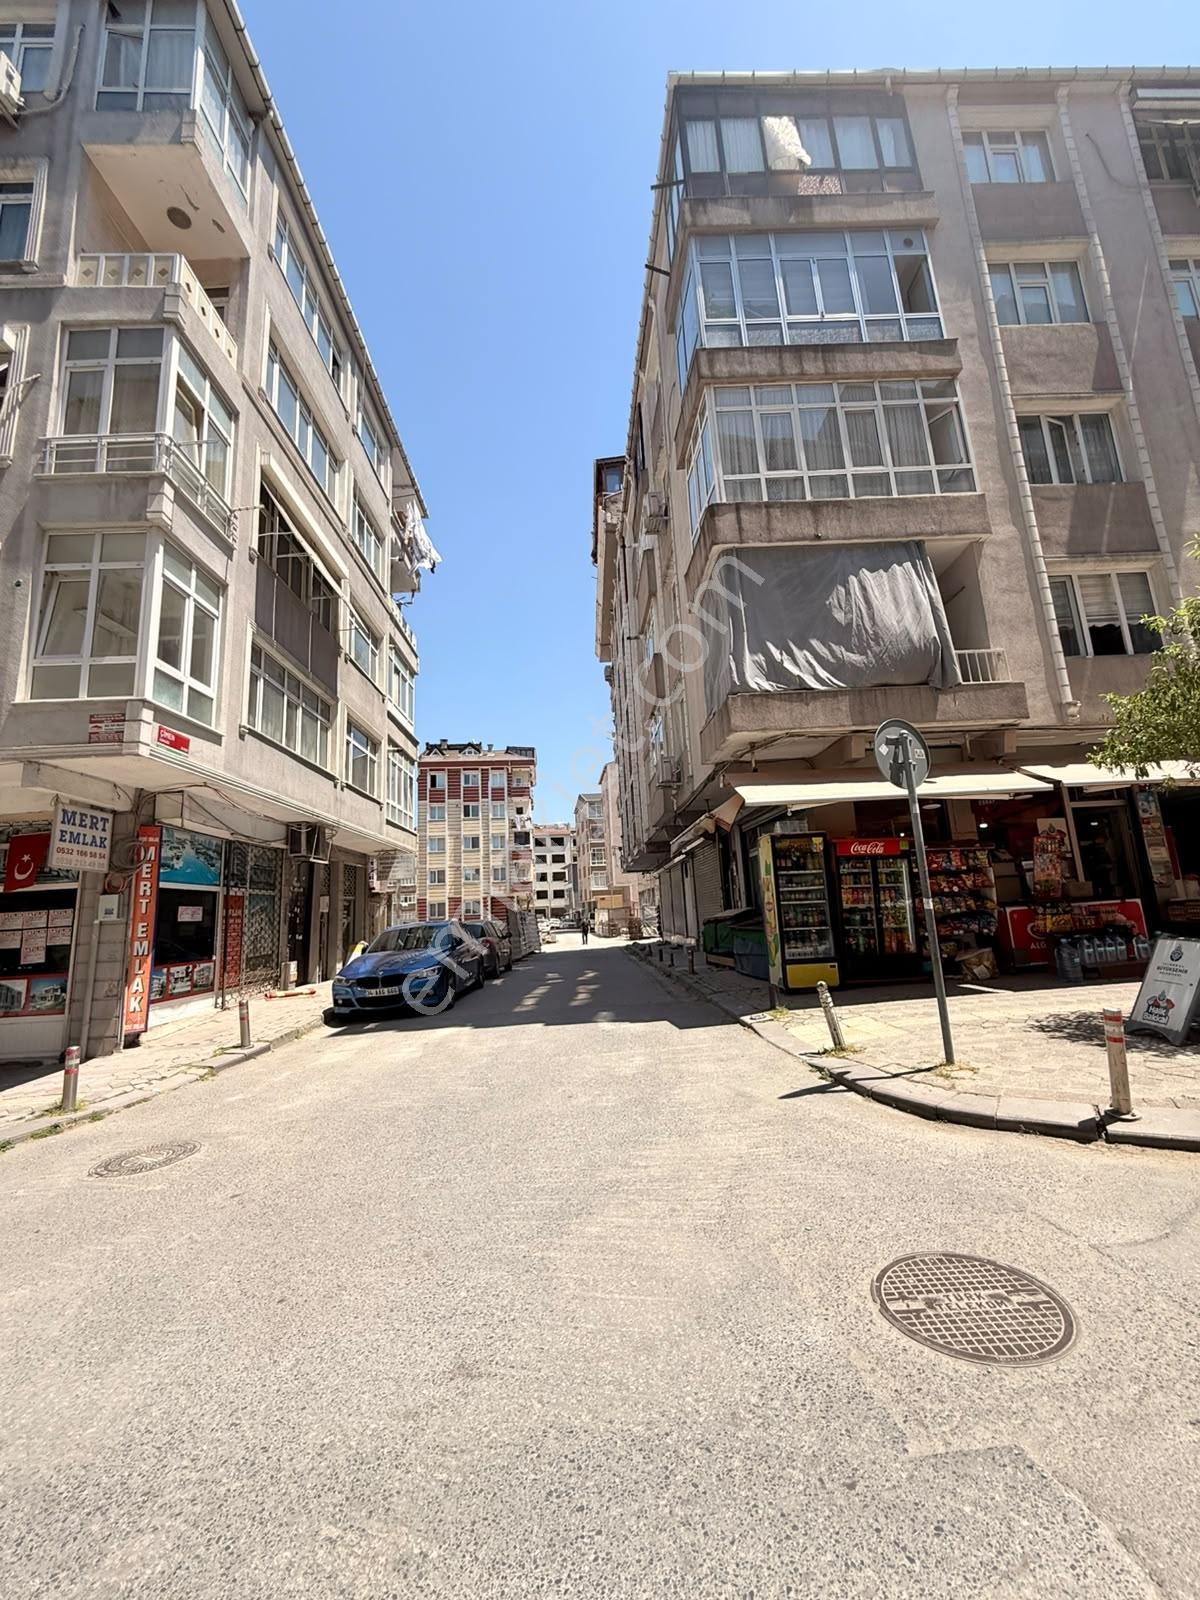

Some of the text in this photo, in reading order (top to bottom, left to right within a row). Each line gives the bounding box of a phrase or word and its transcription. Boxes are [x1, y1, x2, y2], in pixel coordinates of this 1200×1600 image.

[61, 809, 109, 832] MERT
[58, 830, 107, 849] EMLAK
[139, 846, 156, 914] MERT
[129, 923, 149, 1012] EMLAK
[935, 1300, 1008, 1311] TELEKOM
